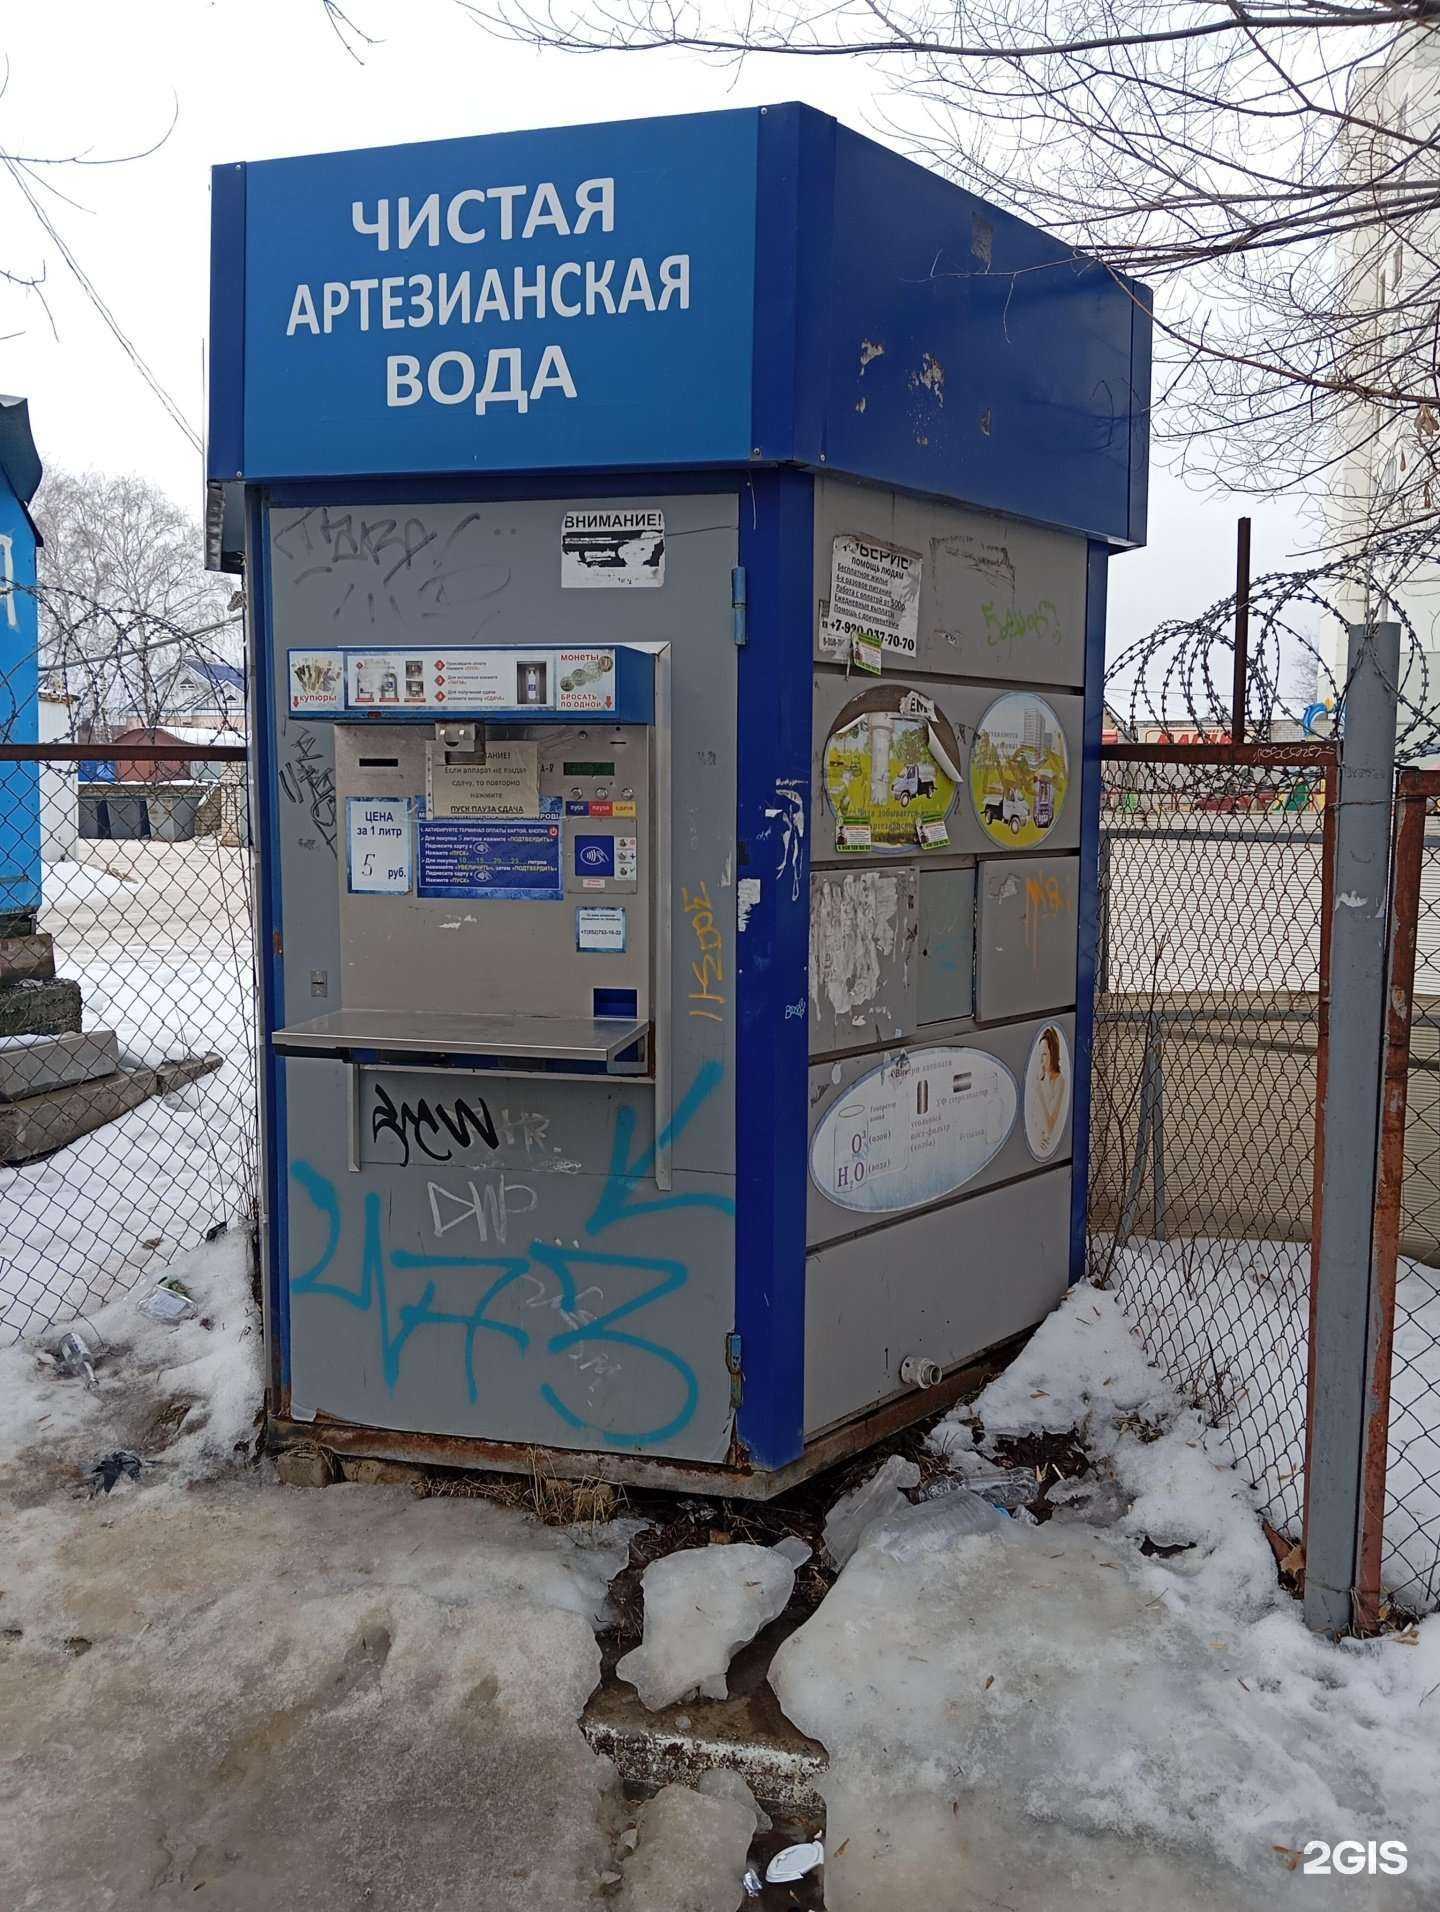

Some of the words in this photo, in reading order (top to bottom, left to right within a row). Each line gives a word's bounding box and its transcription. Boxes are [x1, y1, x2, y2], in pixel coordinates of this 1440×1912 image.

[351, 177, 616, 252] ЧИСТАЯ
[286, 254, 691, 336] АРТЕЗИАНСКАЯ
[386, 345, 578, 415] ВОДА
[564, 513, 662, 528] ВНИМАНИЕ!
[365, 811, 394, 823] ЦЕНА
[357, 828, 368, 836] за
[371, 826, 375, 835] 1
[378, 828, 402, 838] литр
[361, 853, 376, 876] 5
[388, 866, 407, 879] руб.
